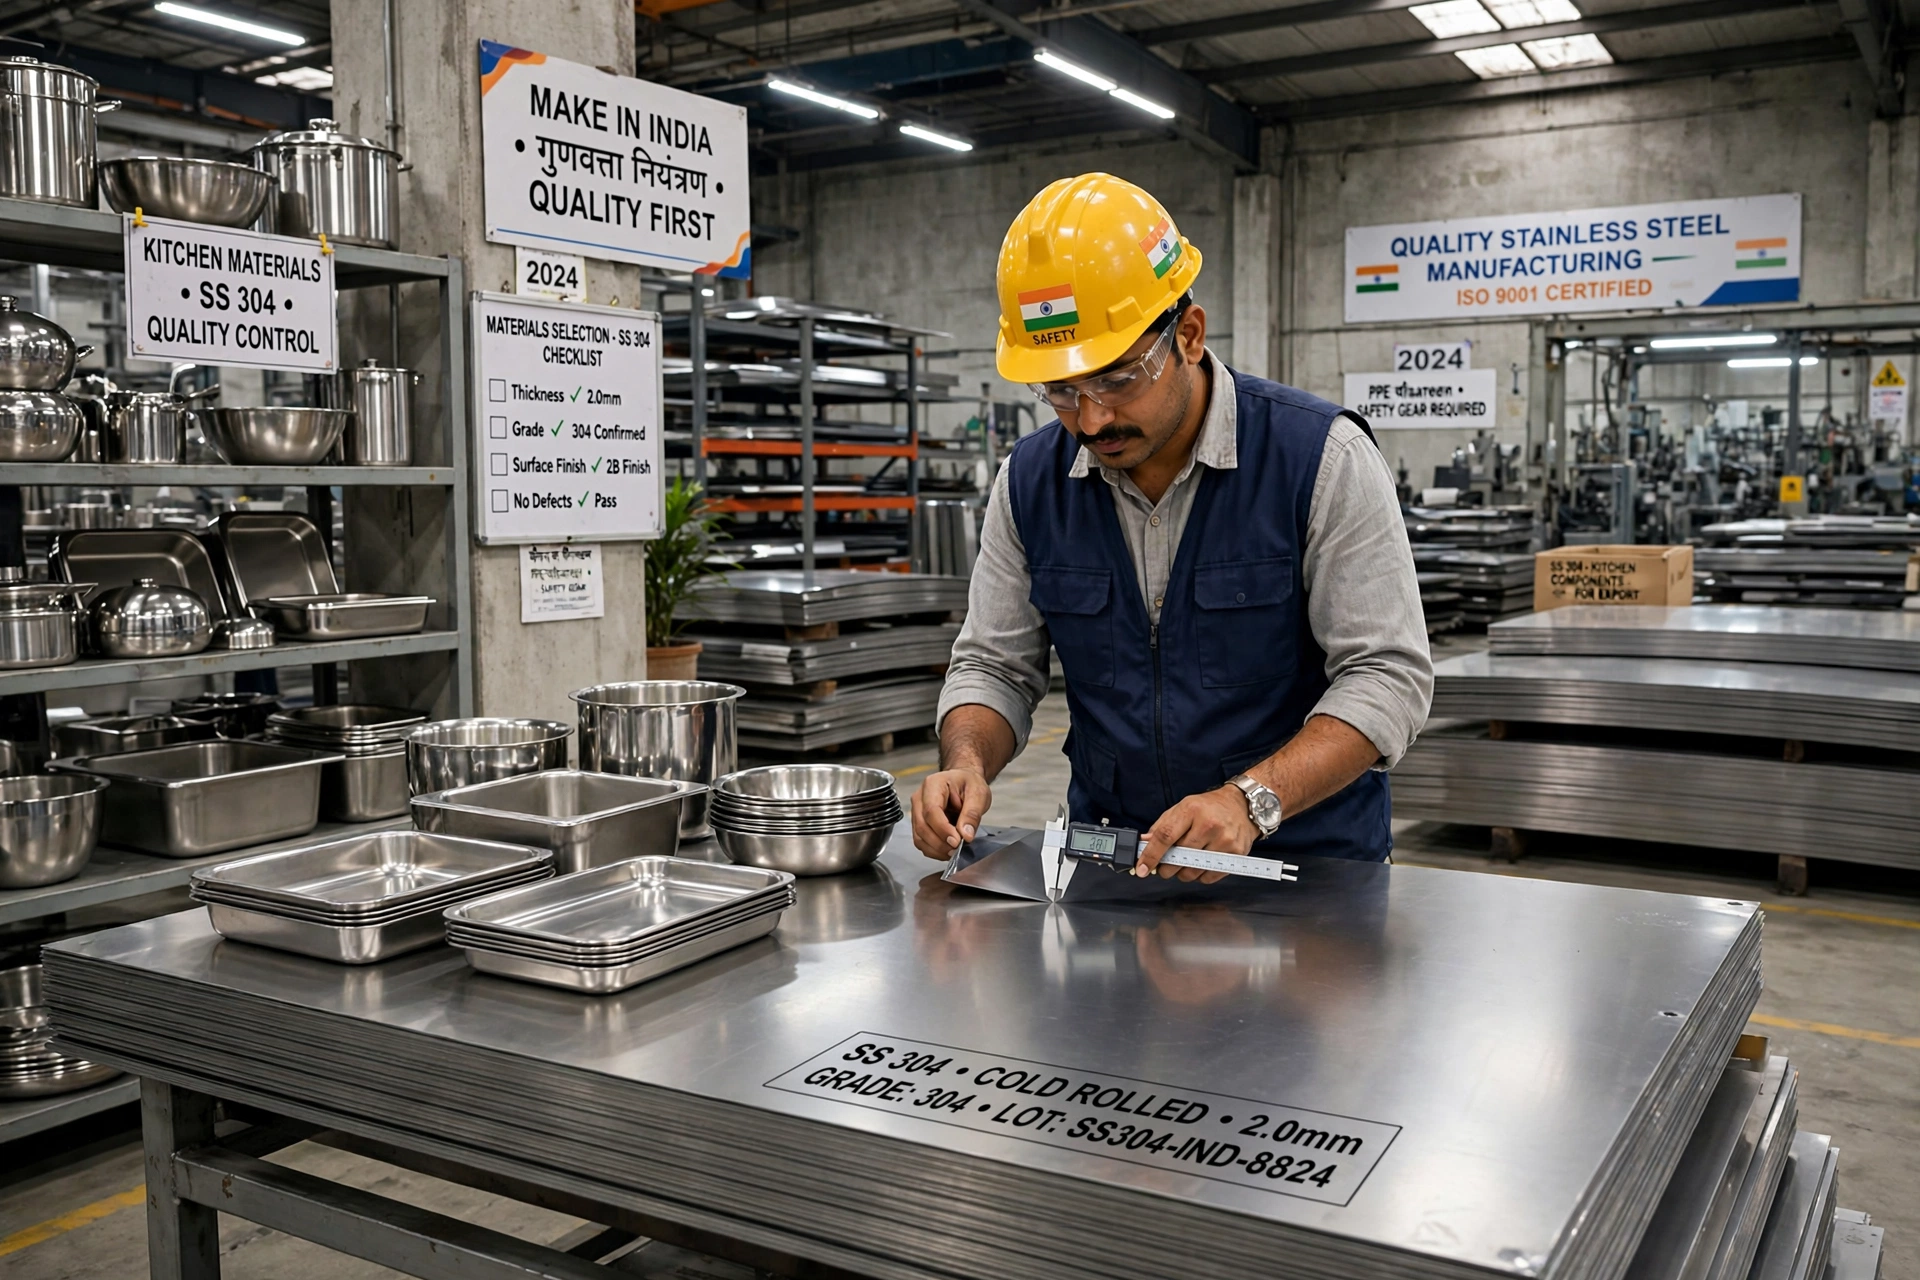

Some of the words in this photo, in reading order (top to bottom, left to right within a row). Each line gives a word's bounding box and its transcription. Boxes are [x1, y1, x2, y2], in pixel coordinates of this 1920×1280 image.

[530, 83, 608, 132] MAKE
[616, 105, 641, 140] IN
[649, 113, 713, 156] INDIA
[535, 135, 625, 181] गुणवत्ता
[630, 146, 708, 199] नियंत्रण
[529, 179, 642, 229] QUALITY
[650, 202, 716, 241] FIRST
[1391, 232, 1493, 257] QUALITY
[1501, 221, 1637, 249] STAINLESS
[1646, 214, 1730, 239] STEEL
[143, 236, 223, 271] KITCHEN
[228, 247, 321, 283] MATERIALS
[526, 260, 579, 289] 2024
[1427, 249, 1643, 282] MANUFACTURING
[199, 280, 230, 311] SS
[237, 285, 277, 316] 304
[1457, 289, 1489, 306] ISO
[1496, 286, 1537, 304] 9001
[1545, 278, 1652, 302] CERTIFIED
[147, 315, 230, 347] QUALITY
[235, 323, 320, 354] CONTROL
[486, 315, 550, 339] MATERIALS
[551, 321, 610, 344] SELECTION
[618, 328, 632, 347] SS
[633, 330, 651, 348] 304
[1032, 328, 1076, 346] SAFETY
[542, 345, 603, 367] CHECKLIST
[1398, 348, 1464, 371] 2024
[511, 383, 565, 403] Thickness
[587, 388, 622, 406] 2.0mm
[1369, 385, 1391, 400] PPE
[1357, 402, 1395, 418] SAFETY
[1398, 402, 1427, 417] GEAR
[511, 420, 545, 438] Grade
[571, 422, 592, 439] 304
[593, 423, 646, 441] Confirmed
[512, 455, 554, 474] Surface
[556, 457, 587, 474] Finish
[606, 458, 621, 475] 2B
[622, 458, 651, 475] Finish
[513, 492, 530, 509] No
[532, 492, 573, 509] Defects
[594, 492, 618, 509] Pass
[842, 1043, 895, 1065] SS
[887, 1051, 954, 1076] 304
[973, 1066, 1070, 1098] COLD
[1065, 1082, 1210, 1125] ROLLED
[1237, 1114, 1363, 1156] 2.0mm
[804, 1067, 916, 1102] GRADE:
[913, 1087, 977, 1113] 304
[991, 1102, 1067, 1133] LOT:
[1066, 1116, 1338, 1188] SS304-IND-8824
